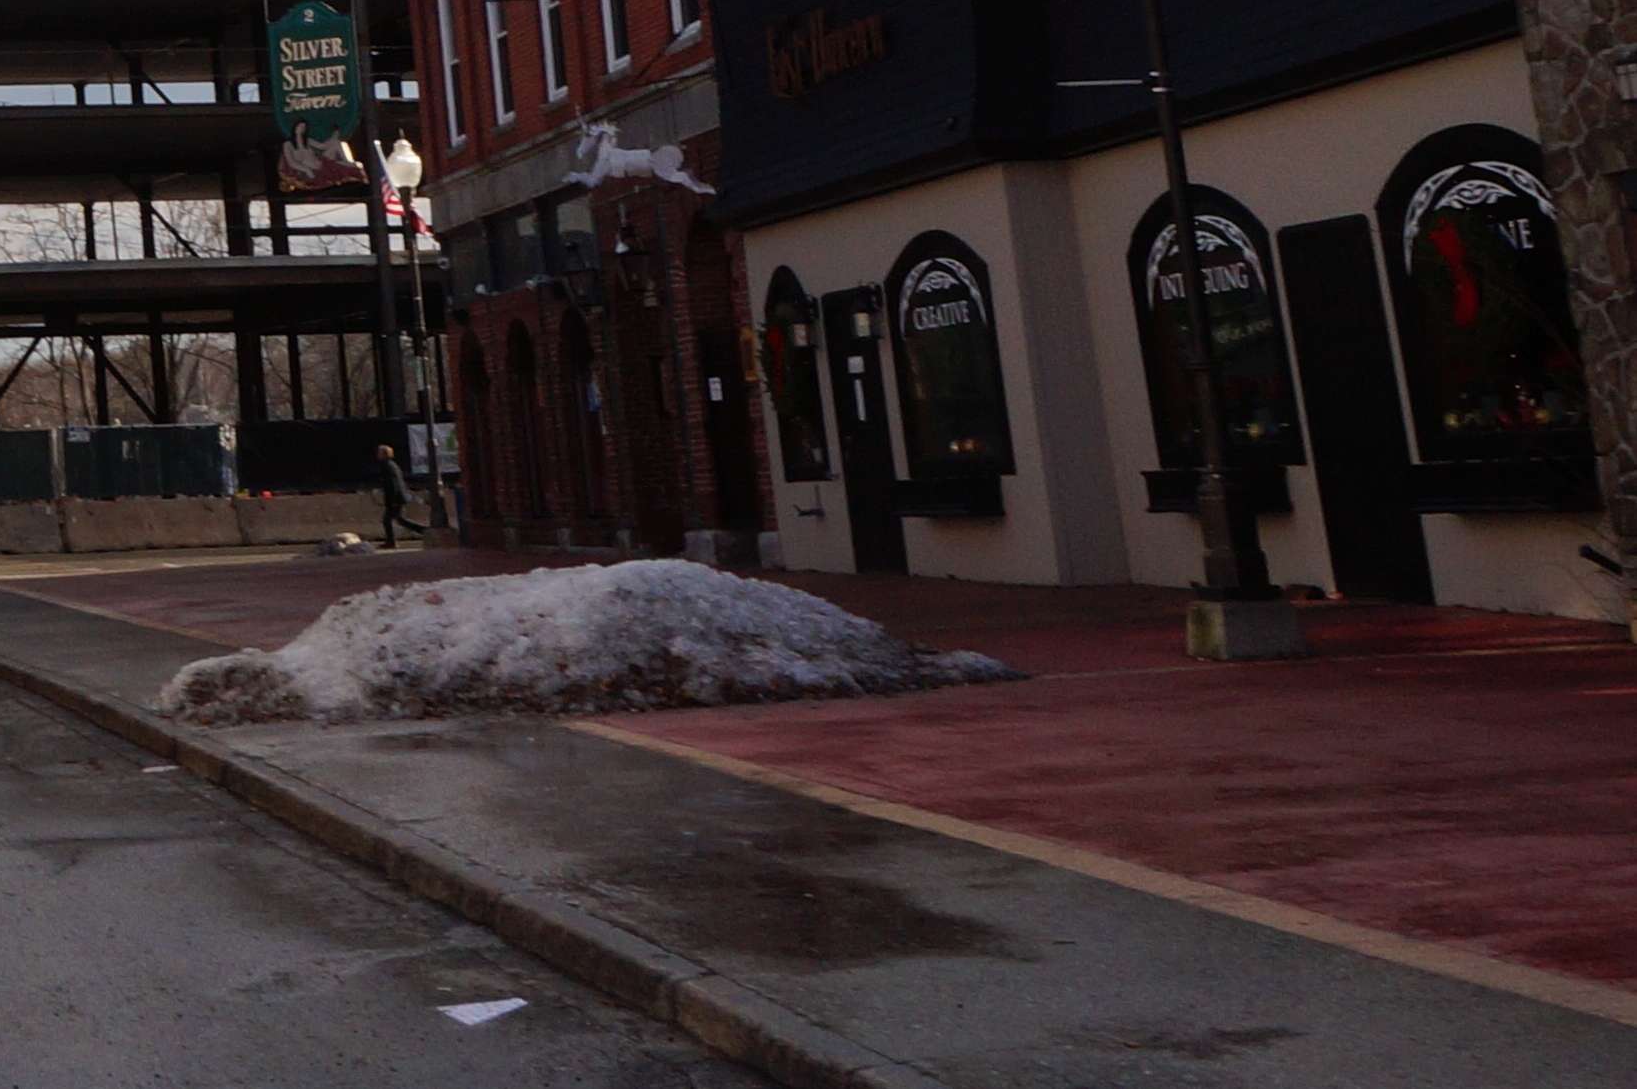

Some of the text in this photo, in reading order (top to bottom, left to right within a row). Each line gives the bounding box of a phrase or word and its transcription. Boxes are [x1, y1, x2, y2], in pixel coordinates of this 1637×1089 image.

[303, 9, 315, 22] 2
[279, 37, 347, 63] SILVER
[281, 65, 347, 91] STREET
[284, 92, 347, 113] Tavern
[913, 300, 971, 331] CREATIVE
